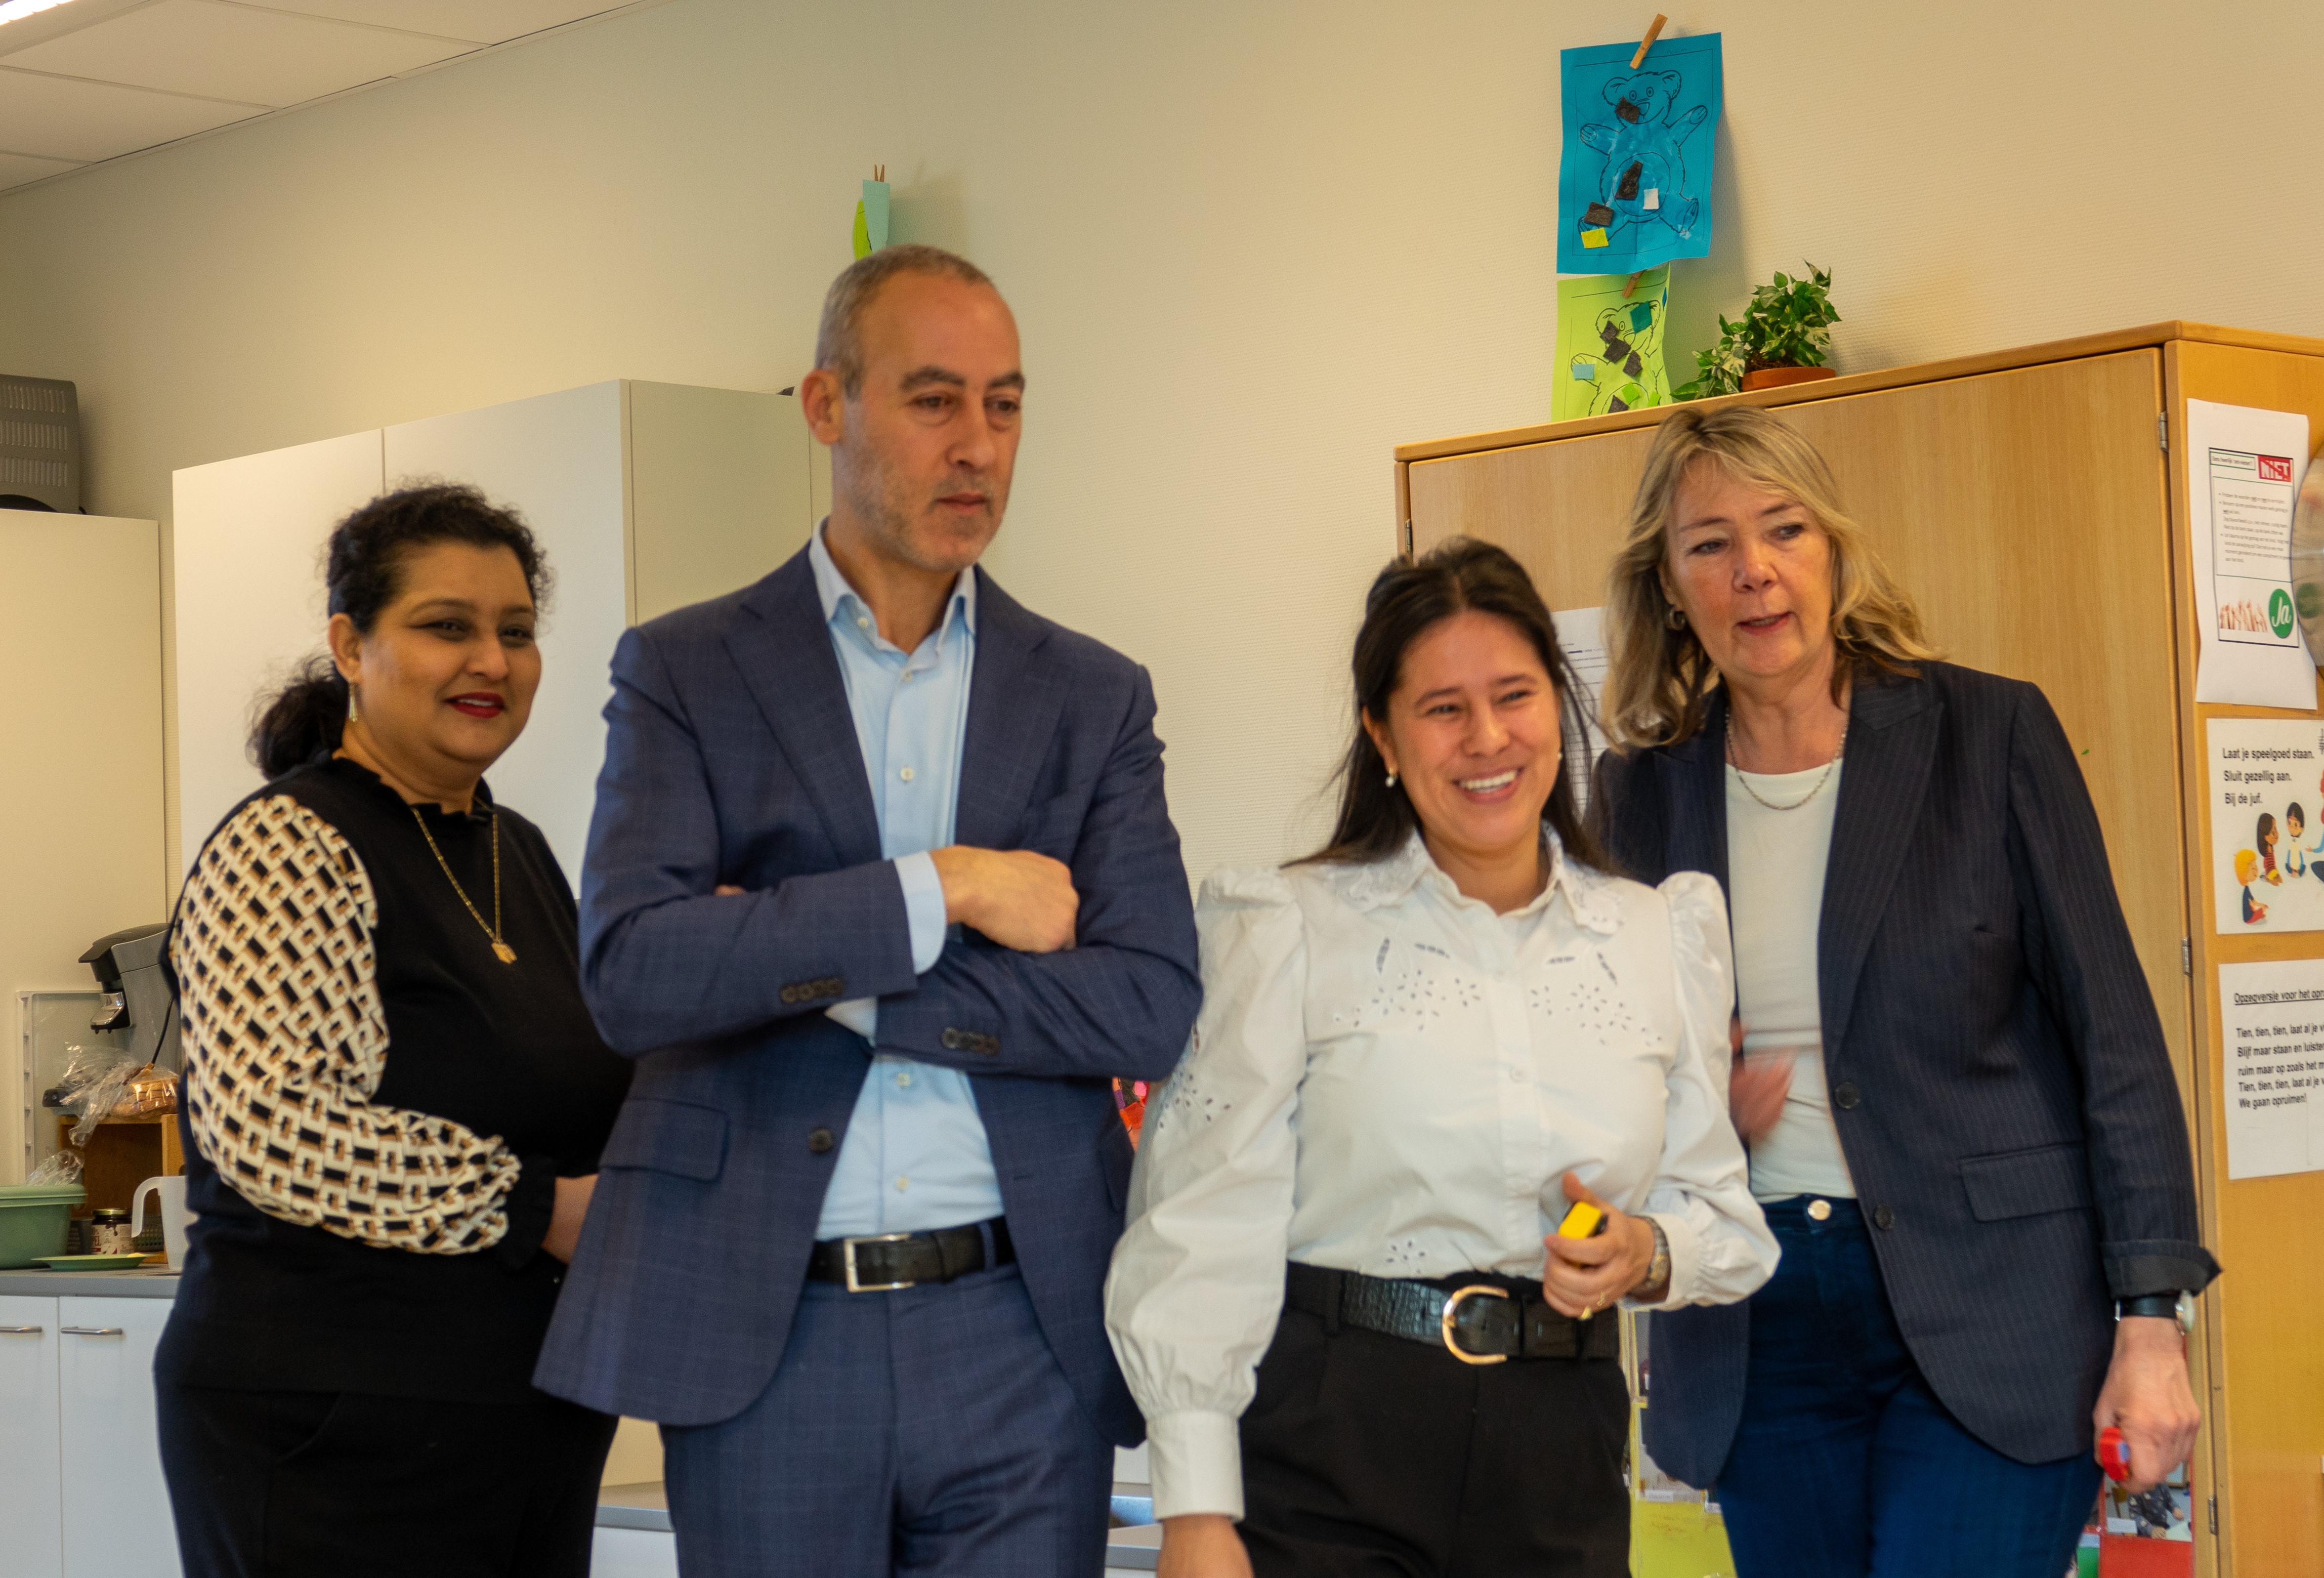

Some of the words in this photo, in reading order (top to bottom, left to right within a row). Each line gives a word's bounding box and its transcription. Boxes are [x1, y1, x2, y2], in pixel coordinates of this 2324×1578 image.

[2260, 460, 2289, 480] NIET
[2271, 596, 2292, 627] Ja
[2222, 748, 2240, 758] Laat
[2242, 748, 2249, 761] je
[2252, 748, 2291, 761] speelgoed
[2293, 749, 2315, 759] staan.
[2224, 770, 2242, 781] Sluit
[2244, 770, 2274, 783] gezellig
[2276, 772, 2292, 781] aan.
[2225, 793, 2236, 806] Bij
[2238, 793, 2248, 804] de
[2234, 990, 2279, 1004] Opzegversje
[2281, 991, 2297, 1000] voor
[2299, 989, 2310, 999] het
[2311, 990, 2324, 1000] opr
[2236, 1027, 2254, 1039] Tien,
[2255, 1026, 2271, 1037] tien,
[2273, 1025, 2289, 1036] tien,
[2290, 1024, 2302, 1034] laat
[2304, 1023, 2310, 1033] al
[2311, 1023, 2318, 1035] je
[2237, 1046, 2252, 1059] Blijf
[2253, 1047, 2271, 1056] maar
[2273, 1045, 2292, 1054] staan
[2294, 1045, 2302, 1053] en
[2237, 1065, 2255, 1076] ruim
[2256, 1066, 2274, 1074] maar
[2276, 1065, 2285, 1075] op
[2287, 1061, 2304, 1072] zoals
[2306, 1061, 2317, 1070] het
[2238, 1082, 2257, 1092] Tien,
[2258, 1081, 2274, 1092] tien,
[2275, 1078, 2291, 1090] tien,
[2292, 1077, 2304, 1088] laat
[2306, 1076, 2312, 1086] al
[2313, 1075, 2319, 1088] je
[2238, 1098, 2251, 1108] We
[2253, 1098, 2271, 1110] gaan
[2272, 1093, 2307, 1108] opruimen!
